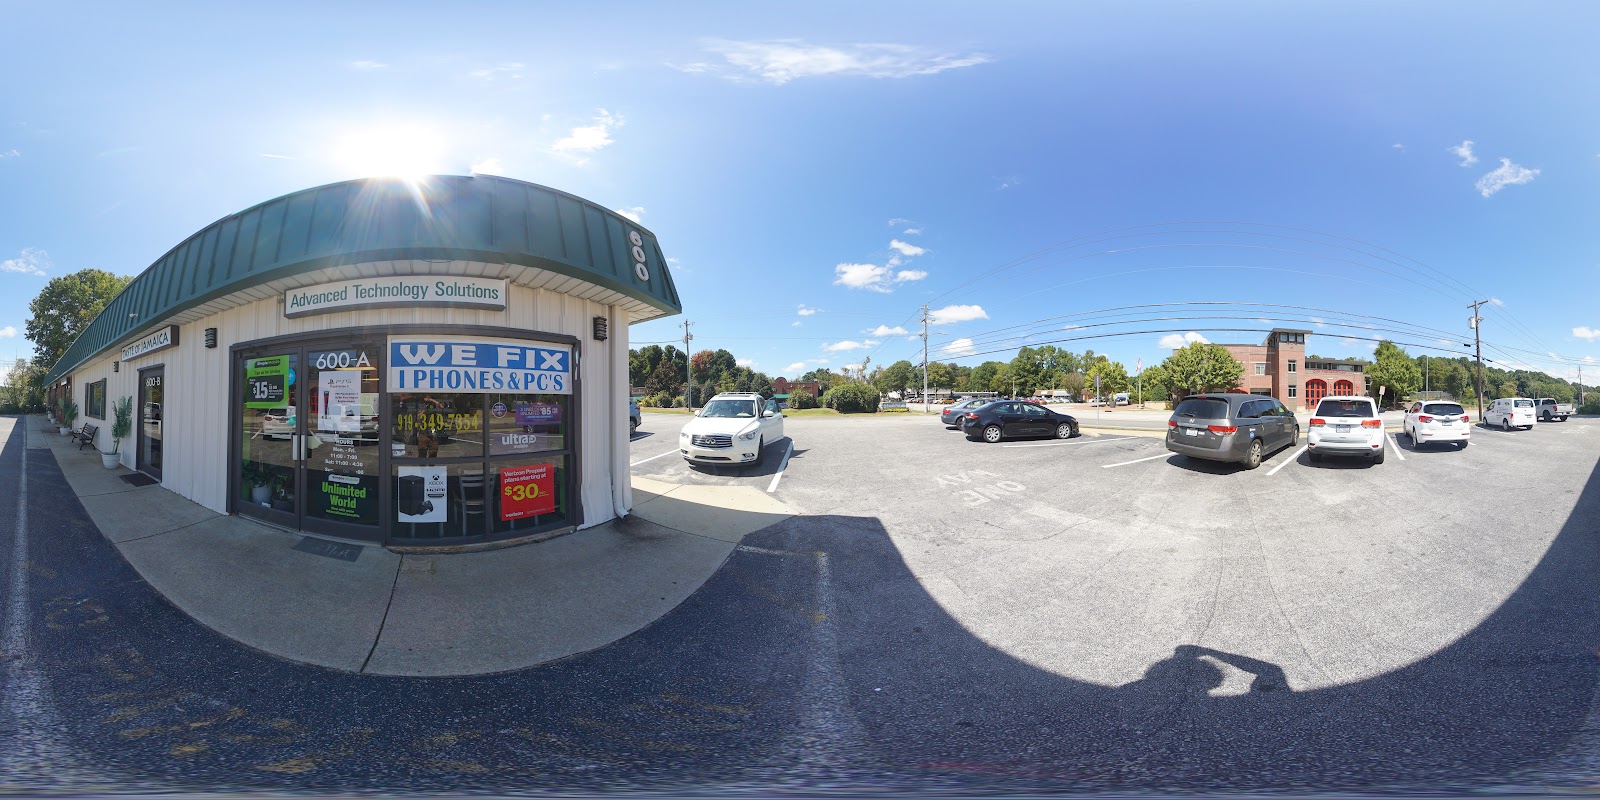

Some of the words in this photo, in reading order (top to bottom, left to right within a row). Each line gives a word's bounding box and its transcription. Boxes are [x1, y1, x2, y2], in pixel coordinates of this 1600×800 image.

[629, 230, 649, 281] 600
[290, 286, 347, 309] Advanced
[353, 281, 429, 300] Technology
[435, 281, 499, 300] Solutions
[122, 345, 134, 359] TASTE
[134, 343, 141, 354] OF
[141, 331, 169, 352] JAMAICA
[316, 351, 371, 370] 600-A
[400, 344, 477, 366] WE
[497, 347, 563, 371] FIX
[145, 376, 161, 387] 600-B
[399, 370, 405, 389] I
[252, 381, 268, 399] $15
[501, 434, 529, 445] ultra
[525, 467, 546, 475] Prepaid
[321, 481, 367, 498] Unlimited
[504, 483, 539, 501] $30
[329, 494, 357, 509] World
